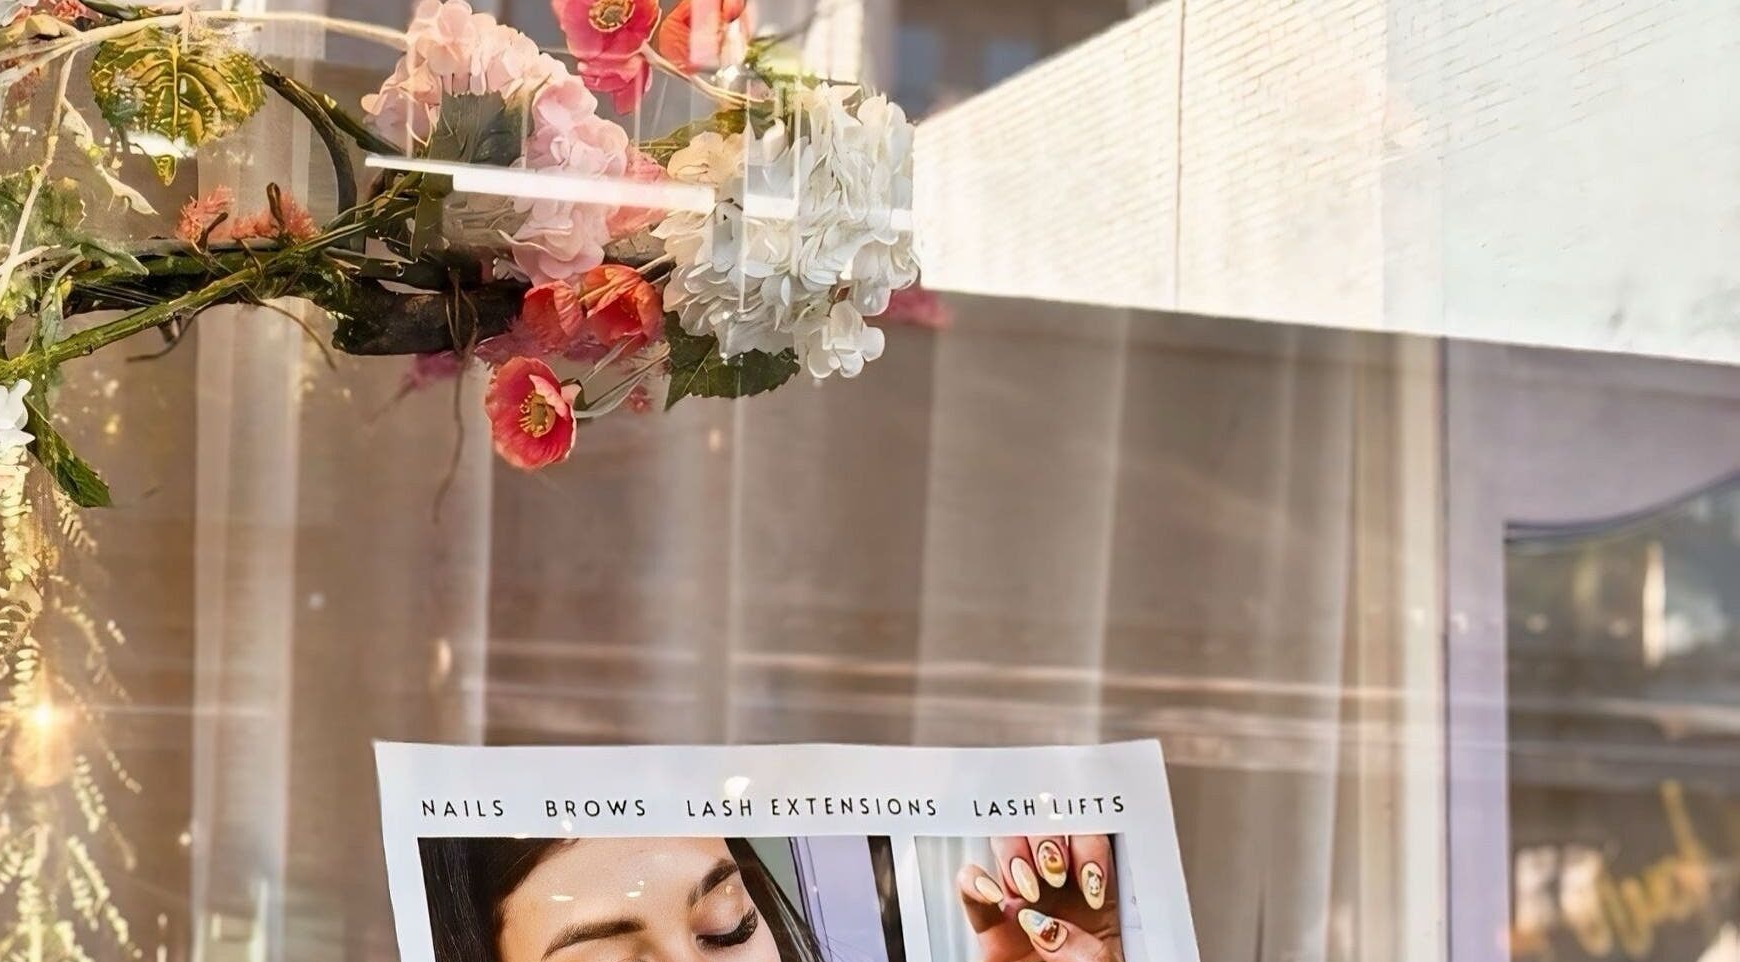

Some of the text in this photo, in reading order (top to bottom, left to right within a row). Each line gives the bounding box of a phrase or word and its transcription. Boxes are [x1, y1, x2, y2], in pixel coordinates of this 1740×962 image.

[420, 795, 1125, 818] NAILS BROWS LASH EXTENSIONS LASH LIFTS
